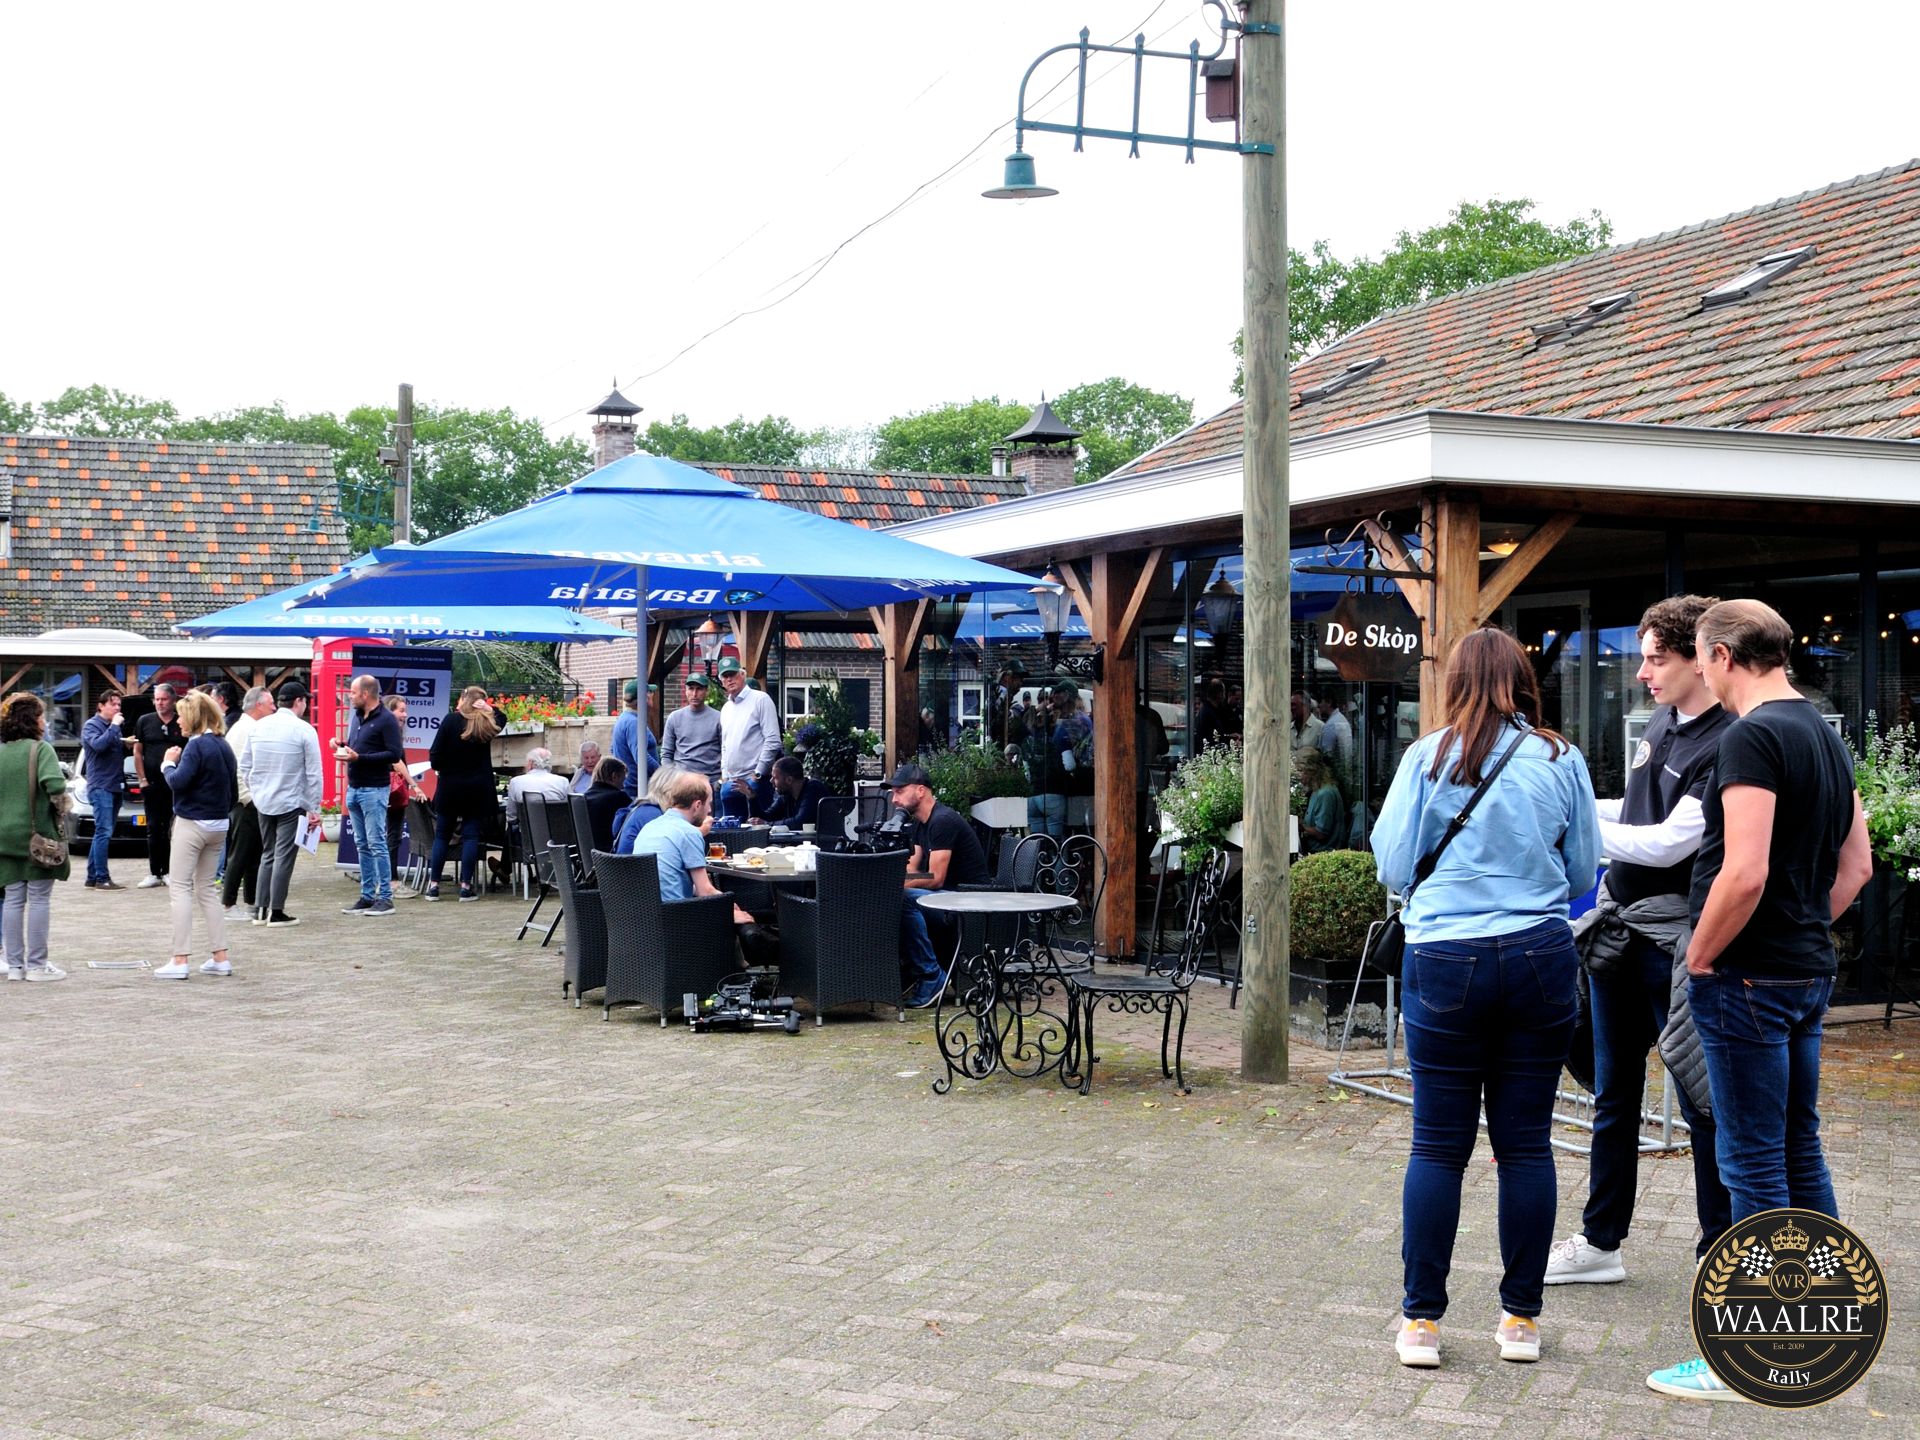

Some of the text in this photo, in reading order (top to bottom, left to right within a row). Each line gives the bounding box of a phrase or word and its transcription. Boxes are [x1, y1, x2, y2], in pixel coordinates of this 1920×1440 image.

[303, 613, 441, 626] Bavaria
[1325, 622, 1418, 654] De Skòp
[405, 698, 434, 707] herstel
[406, 716, 440, 729] ens
